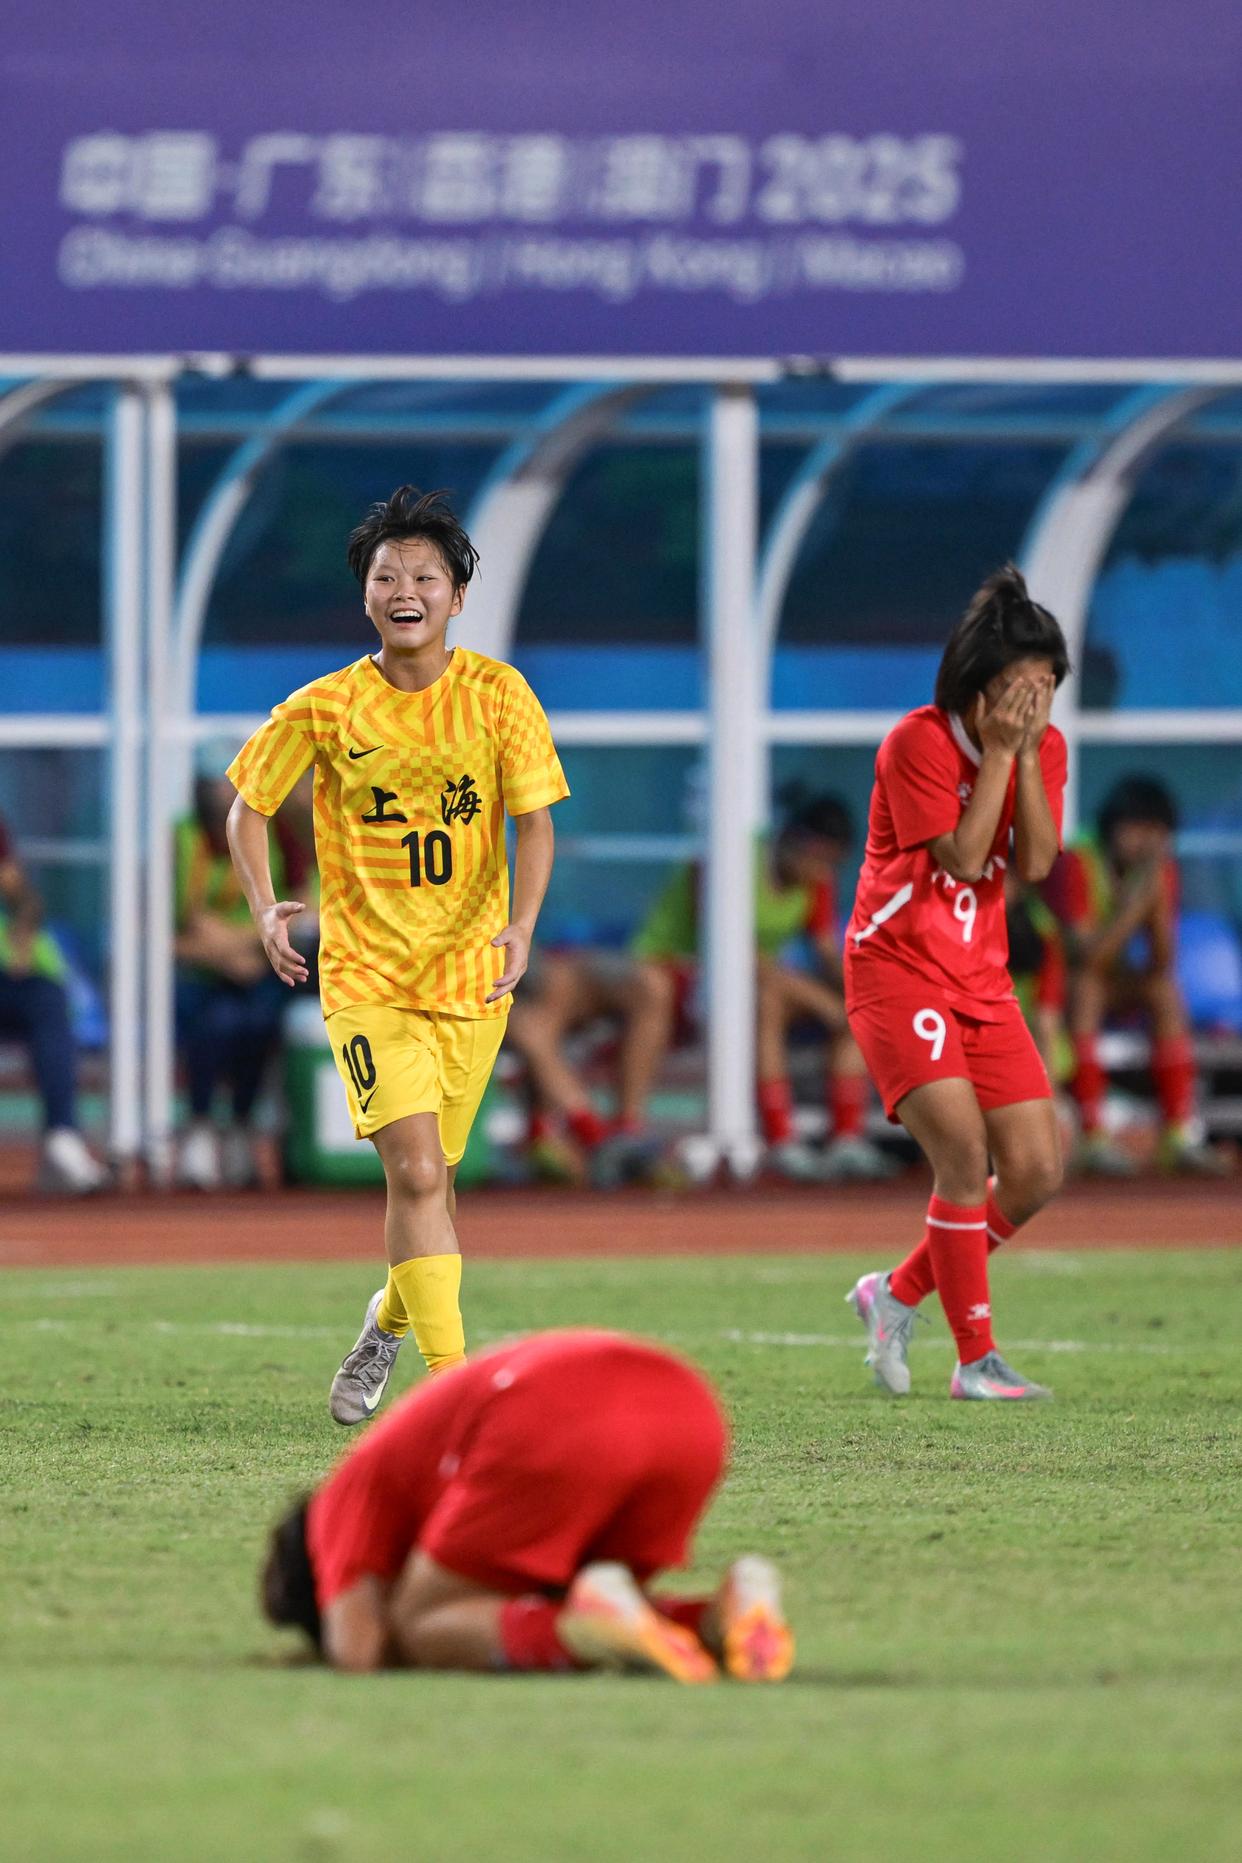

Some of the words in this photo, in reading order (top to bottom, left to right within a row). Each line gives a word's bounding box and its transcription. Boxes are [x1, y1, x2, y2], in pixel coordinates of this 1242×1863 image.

[401, 830, 453, 888] 10
[953, 887, 978, 943] 9
[913, 1008, 946, 1061] 9
[342, 1034, 377, 1099] 10
